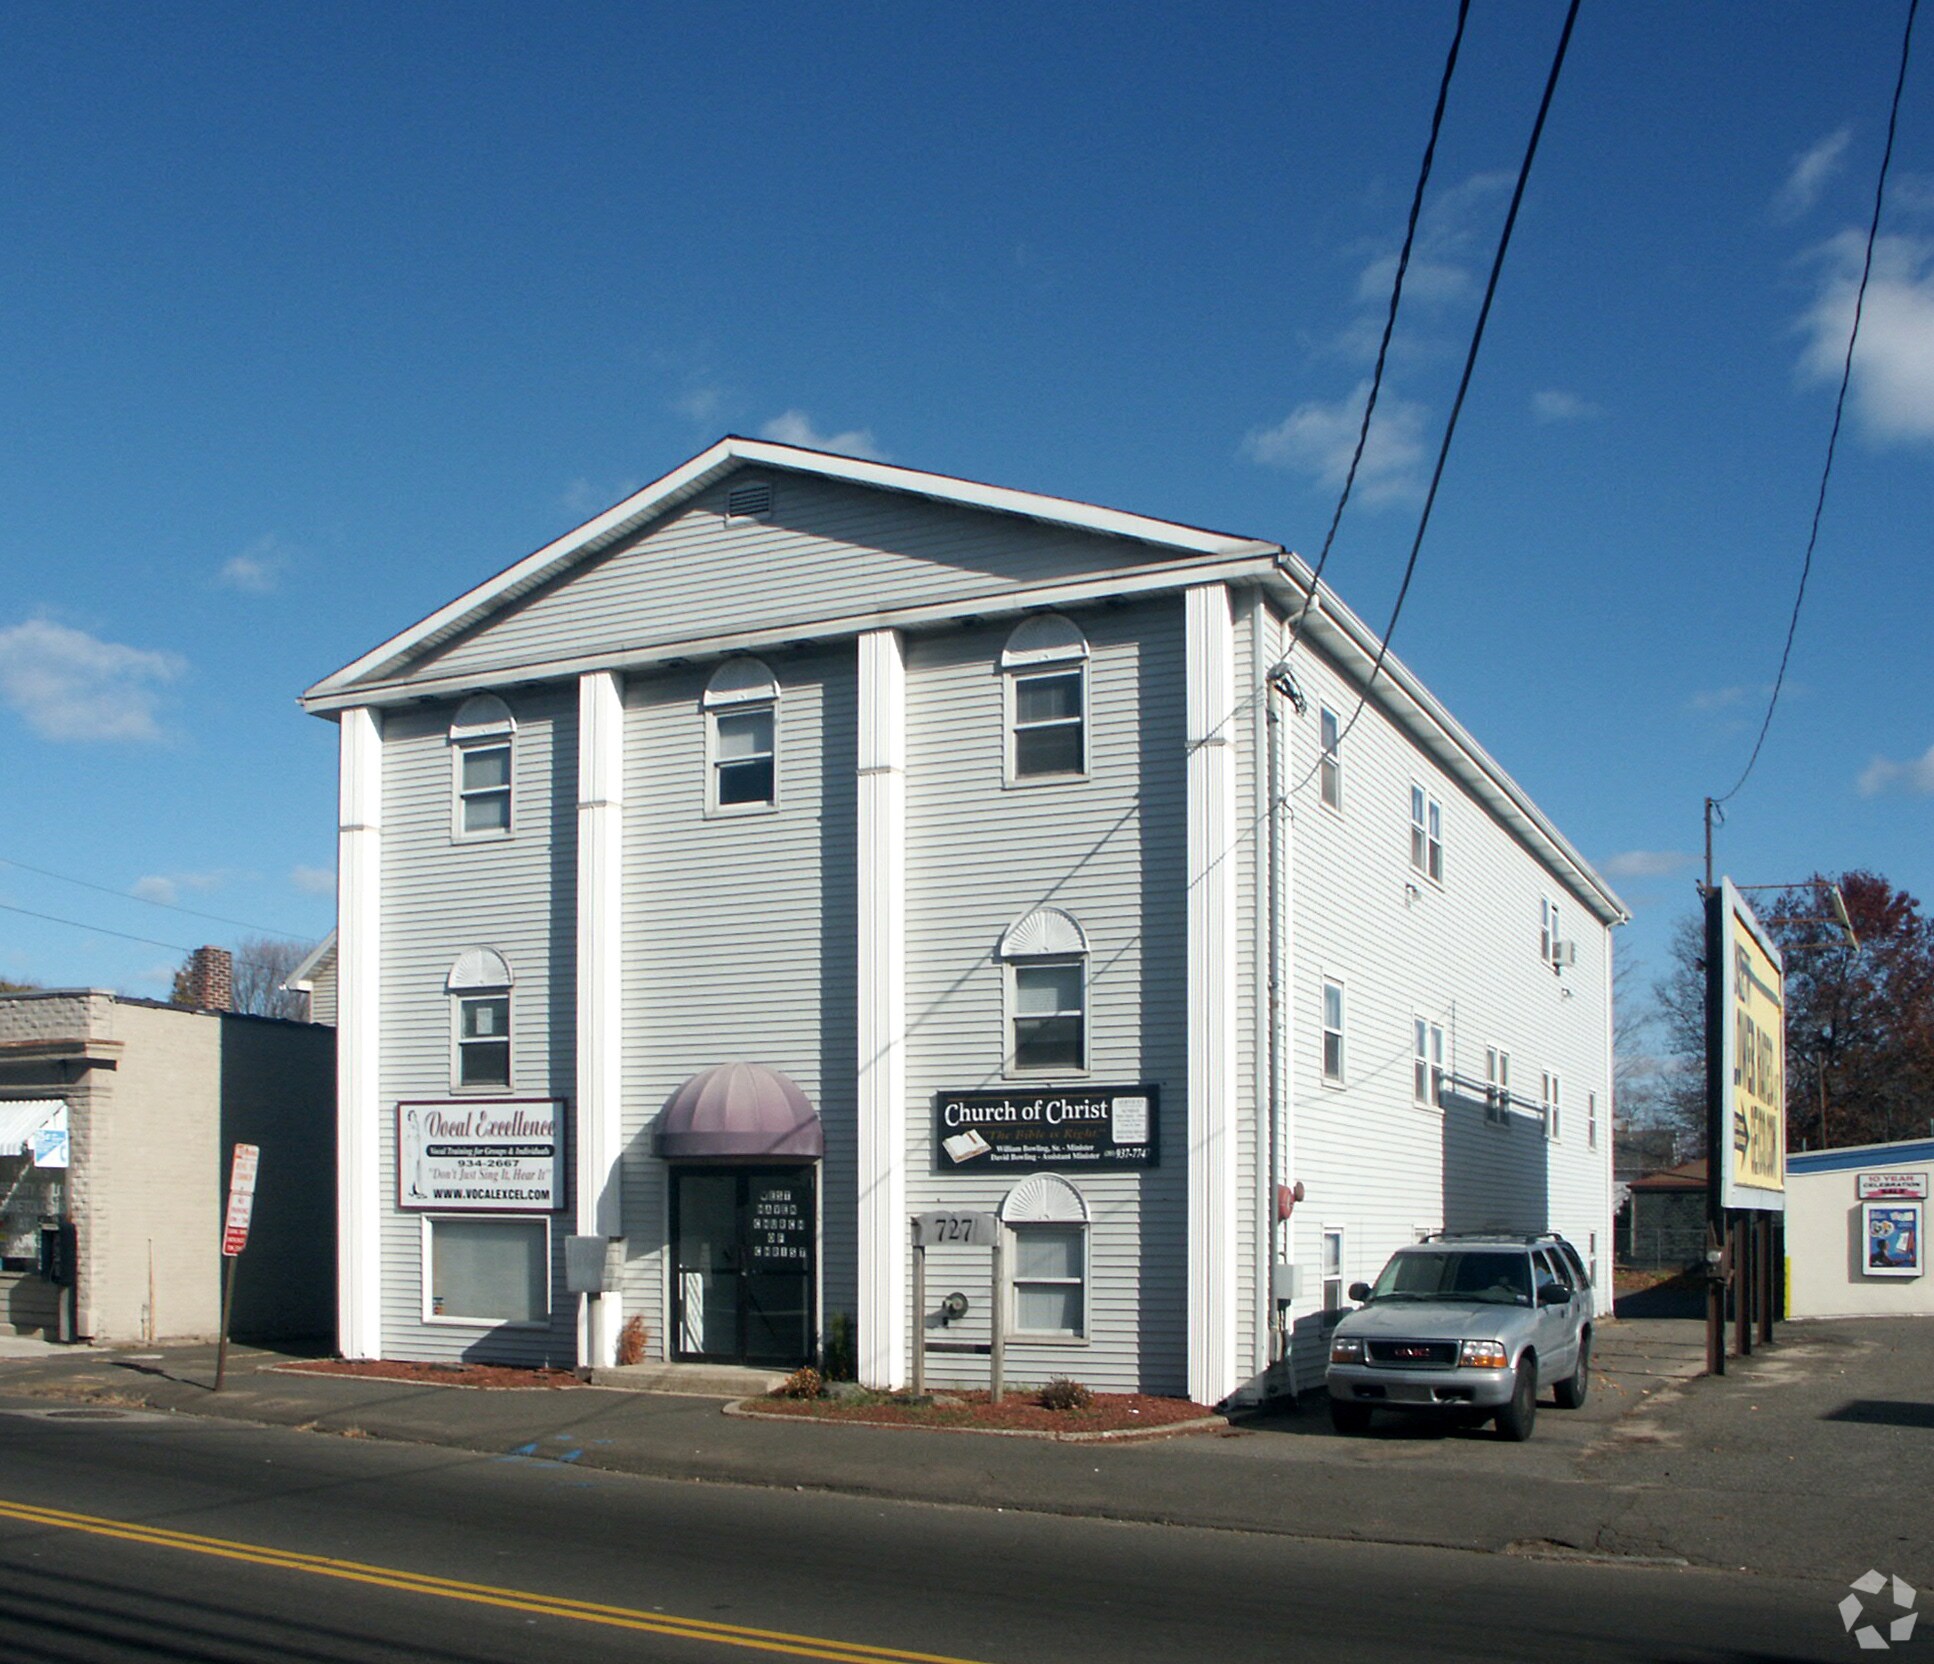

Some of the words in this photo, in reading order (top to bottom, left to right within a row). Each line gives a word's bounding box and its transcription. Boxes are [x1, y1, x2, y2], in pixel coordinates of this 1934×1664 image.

[944, 1101, 1016, 1127] Church
[1021, 1100, 1042, 1121] of
[1046, 1098, 1108, 1124] Christ
[425, 1111, 471, 1138] Vocal
[476, 1110, 556, 1138] Excellence
[1015, 1129, 1043, 1140] Bible
[430, 1147, 446, 1155] Vocal
[447, 1147, 473, 1156] Training
[474, 1147, 483, 1156] for
[484, 1147, 506, 1156] Groups
[508, 1147, 514, 1155] &
[515, 1147, 550, 1155] Individuals
[1066, 1143, 1095, 1151] Minister
[990, 1153, 1010, 1161] David
[1010, 1153, 1037, 1161] Bowling
[1072, 1152, 1101, 1160] Minister
[457, 1159, 520, 1167] 934-2667
[429, 1167, 457, 1180] "Don't
[458, 1168, 476, 1181] Just
[479, 1169, 498, 1182] Sing
[512, 1169, 534, 1180] Hear
[433, 1188, 550, 1200] WWW.VOCALEXCEL.COM
[753, 1218, 805, 1230] CHURCH
[935, 1218, 973, 1242] 727
[767, 1232, 785, 1243] OF
[754, 1246, 807, 1258] CHRIST
[1394, 1348, 1431, 1357] GMC
